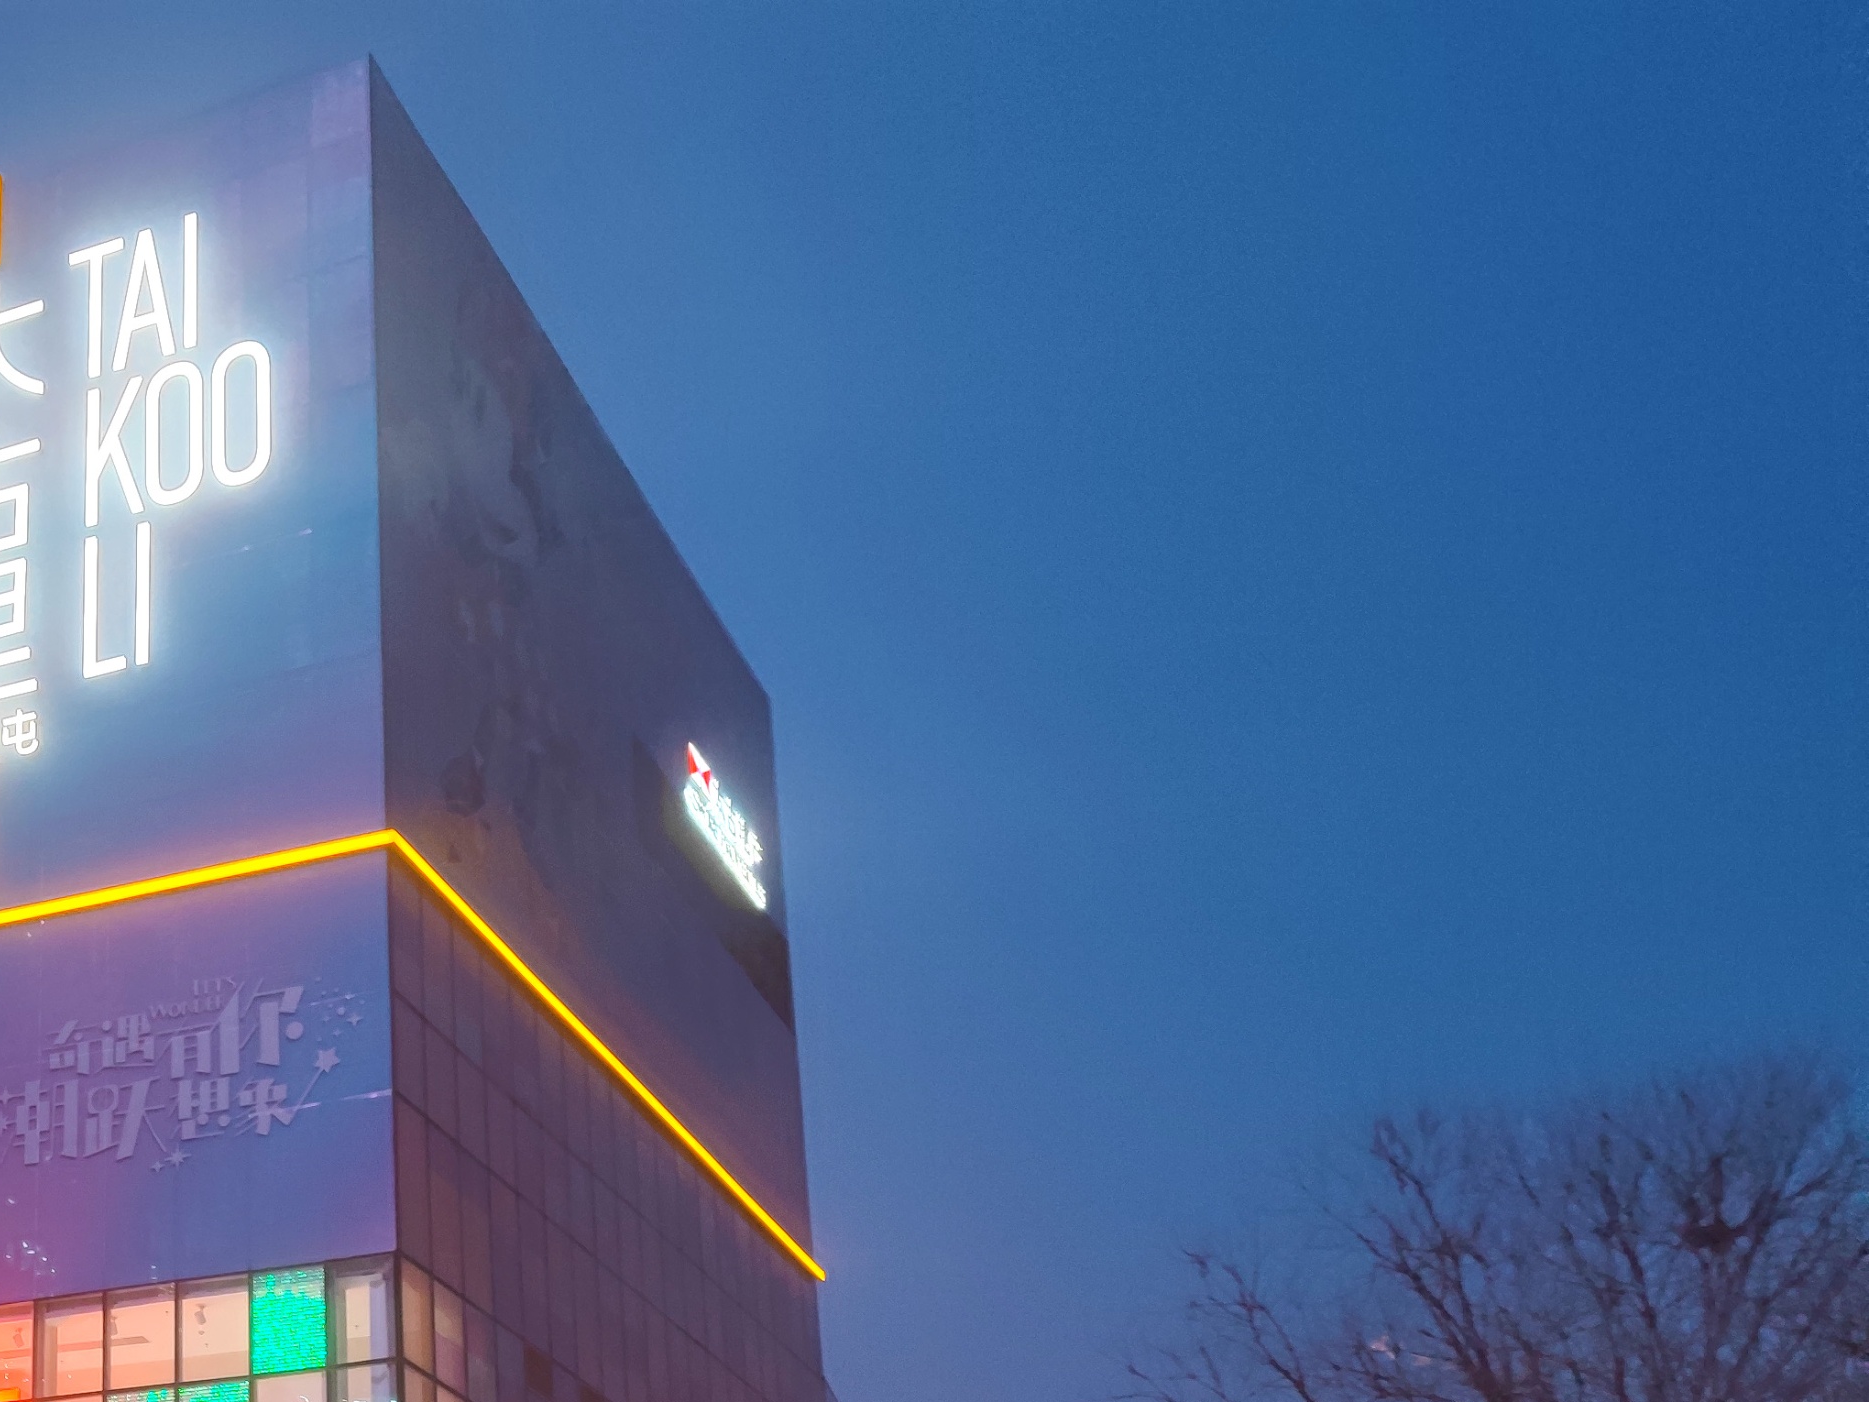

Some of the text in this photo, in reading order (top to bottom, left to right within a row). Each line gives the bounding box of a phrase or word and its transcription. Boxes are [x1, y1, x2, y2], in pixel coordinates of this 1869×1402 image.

[67, 211, 198, 378] TAI
[84, 339, 272, 528] KOO
[81, 520, 151, 679] LI
